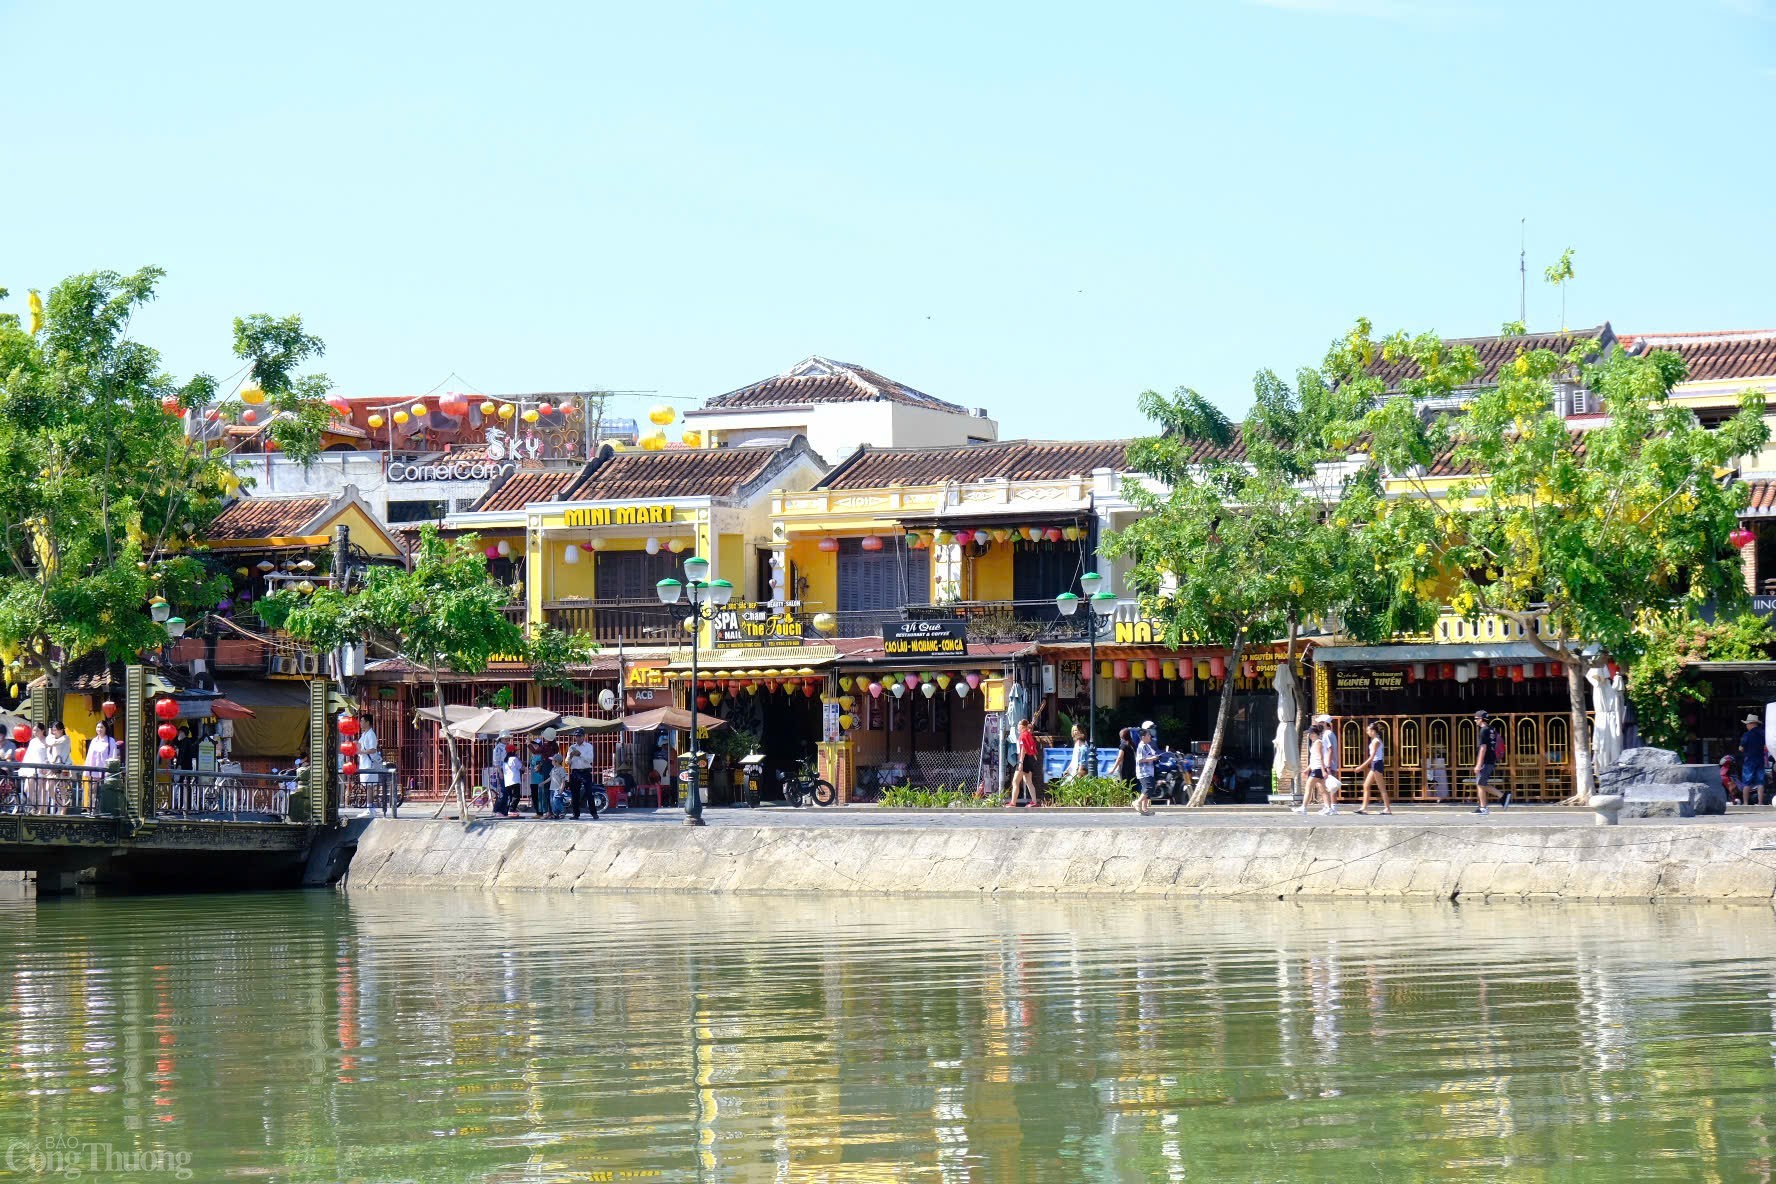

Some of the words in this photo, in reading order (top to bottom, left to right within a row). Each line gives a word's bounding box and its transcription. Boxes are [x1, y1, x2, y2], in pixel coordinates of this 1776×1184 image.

[564, 508, 611, 526] MINI
[616, 505, 674, 524] MART
[715, 611, 739, 630] SPA
[747, 623, 765, 636] The
[766, 612, 802, 636] Touch
[725, 631, 742, 639] NAIL
[885, 641, 897, 653] CAO
[636, 690, 654, 700] ACB
